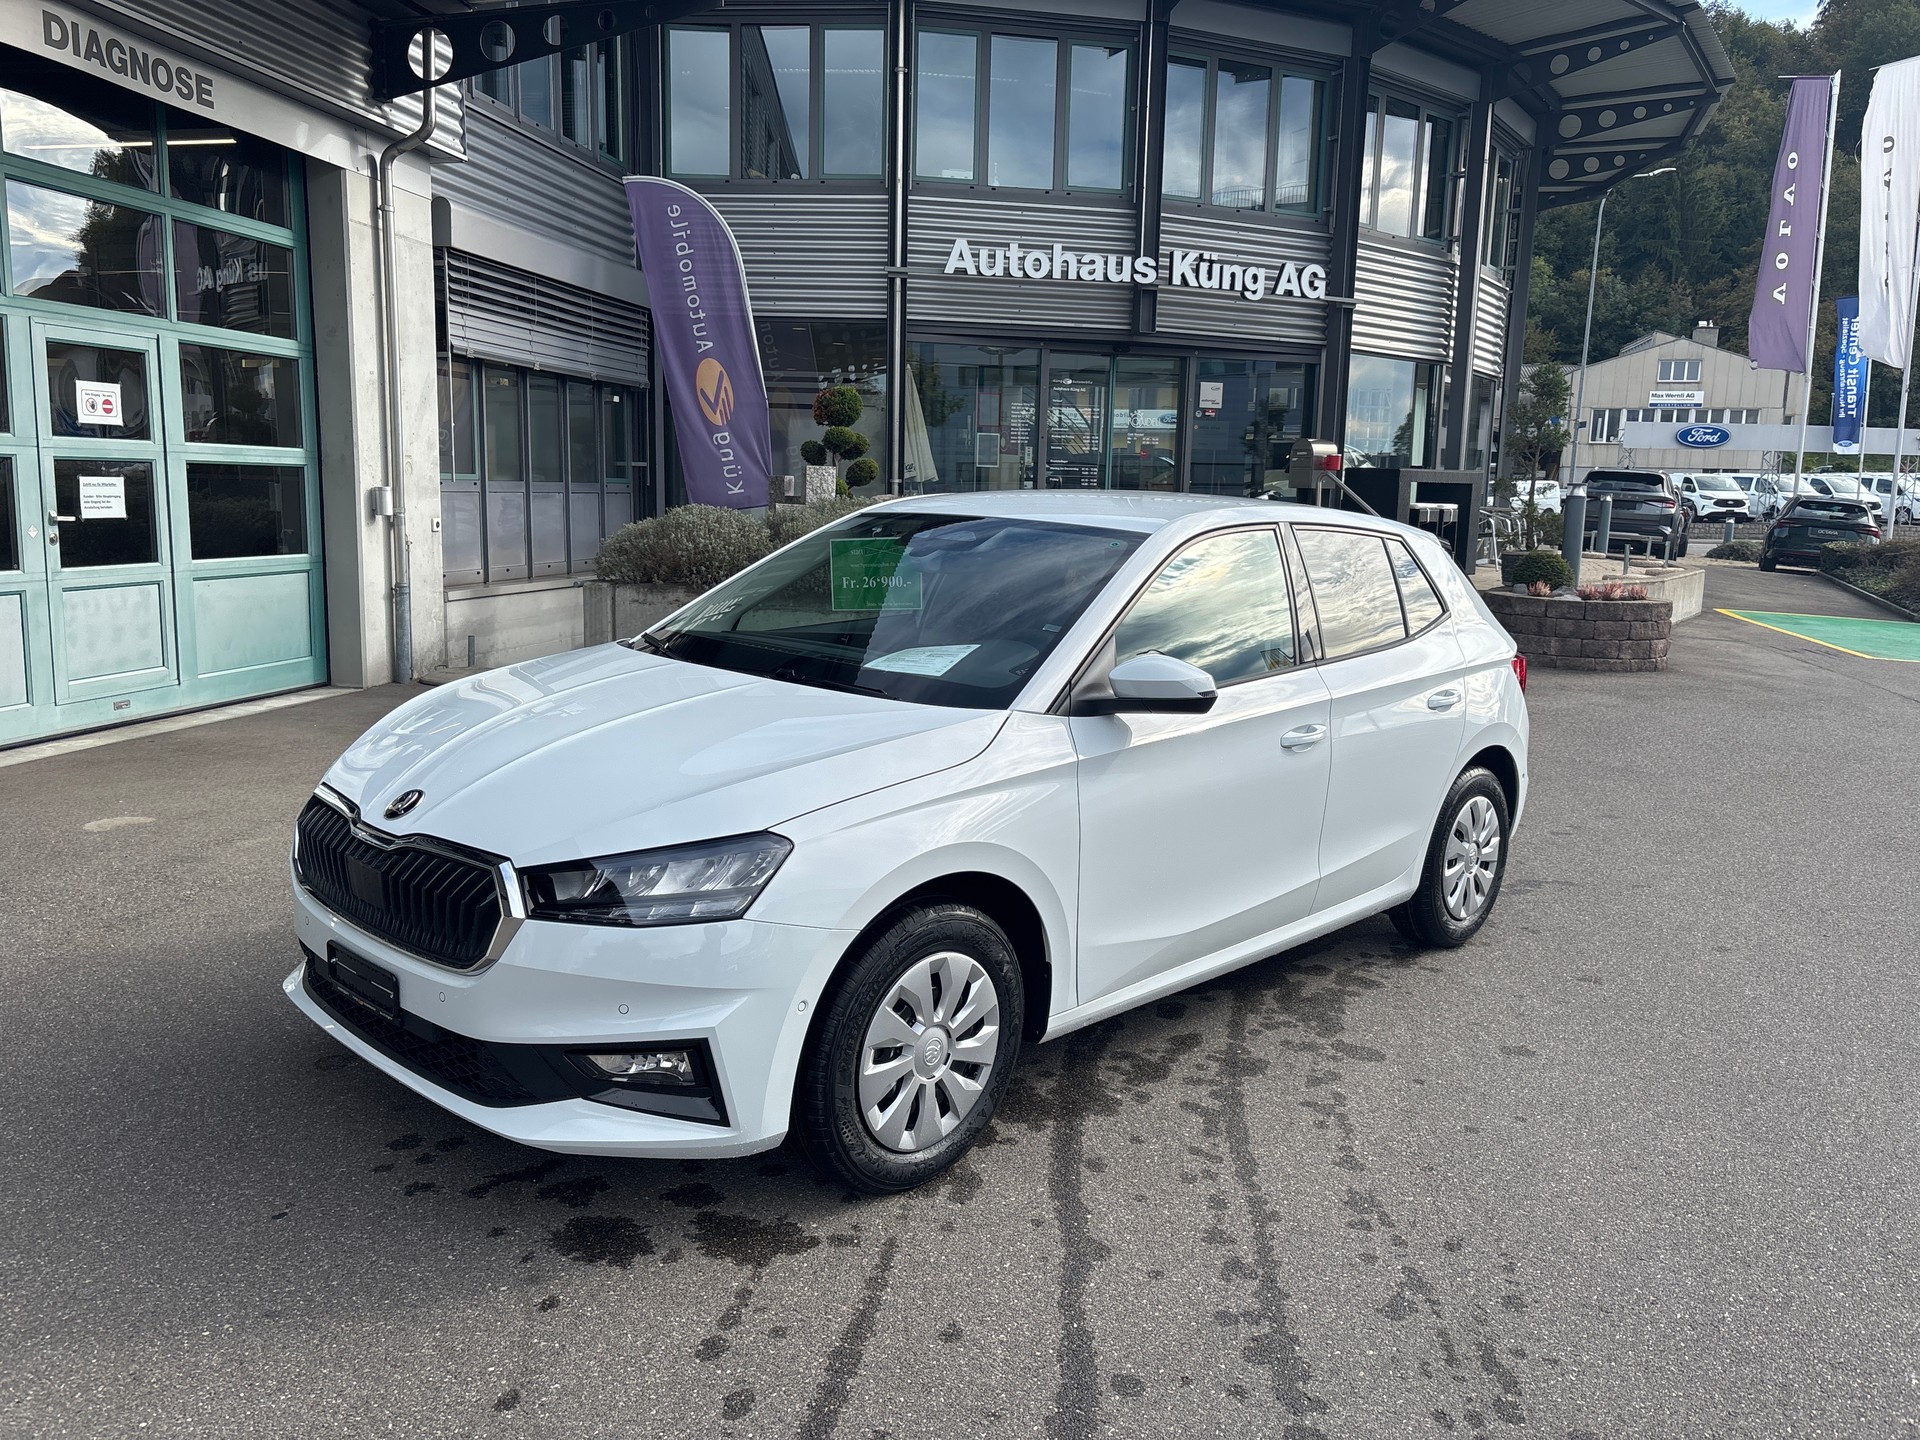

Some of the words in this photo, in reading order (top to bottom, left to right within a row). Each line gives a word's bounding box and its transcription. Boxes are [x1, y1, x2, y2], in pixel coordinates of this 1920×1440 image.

[42, 9, 214, 109] DIAGNOSE
[944, 238, 1158, 285] Autohaus
[1169, 250, 1266, 300] Küng
[1274, 262, 1327, 299] AG
[1687, 427, 1721, 443] Ford
[842, 576, 860, 589] Fr.
